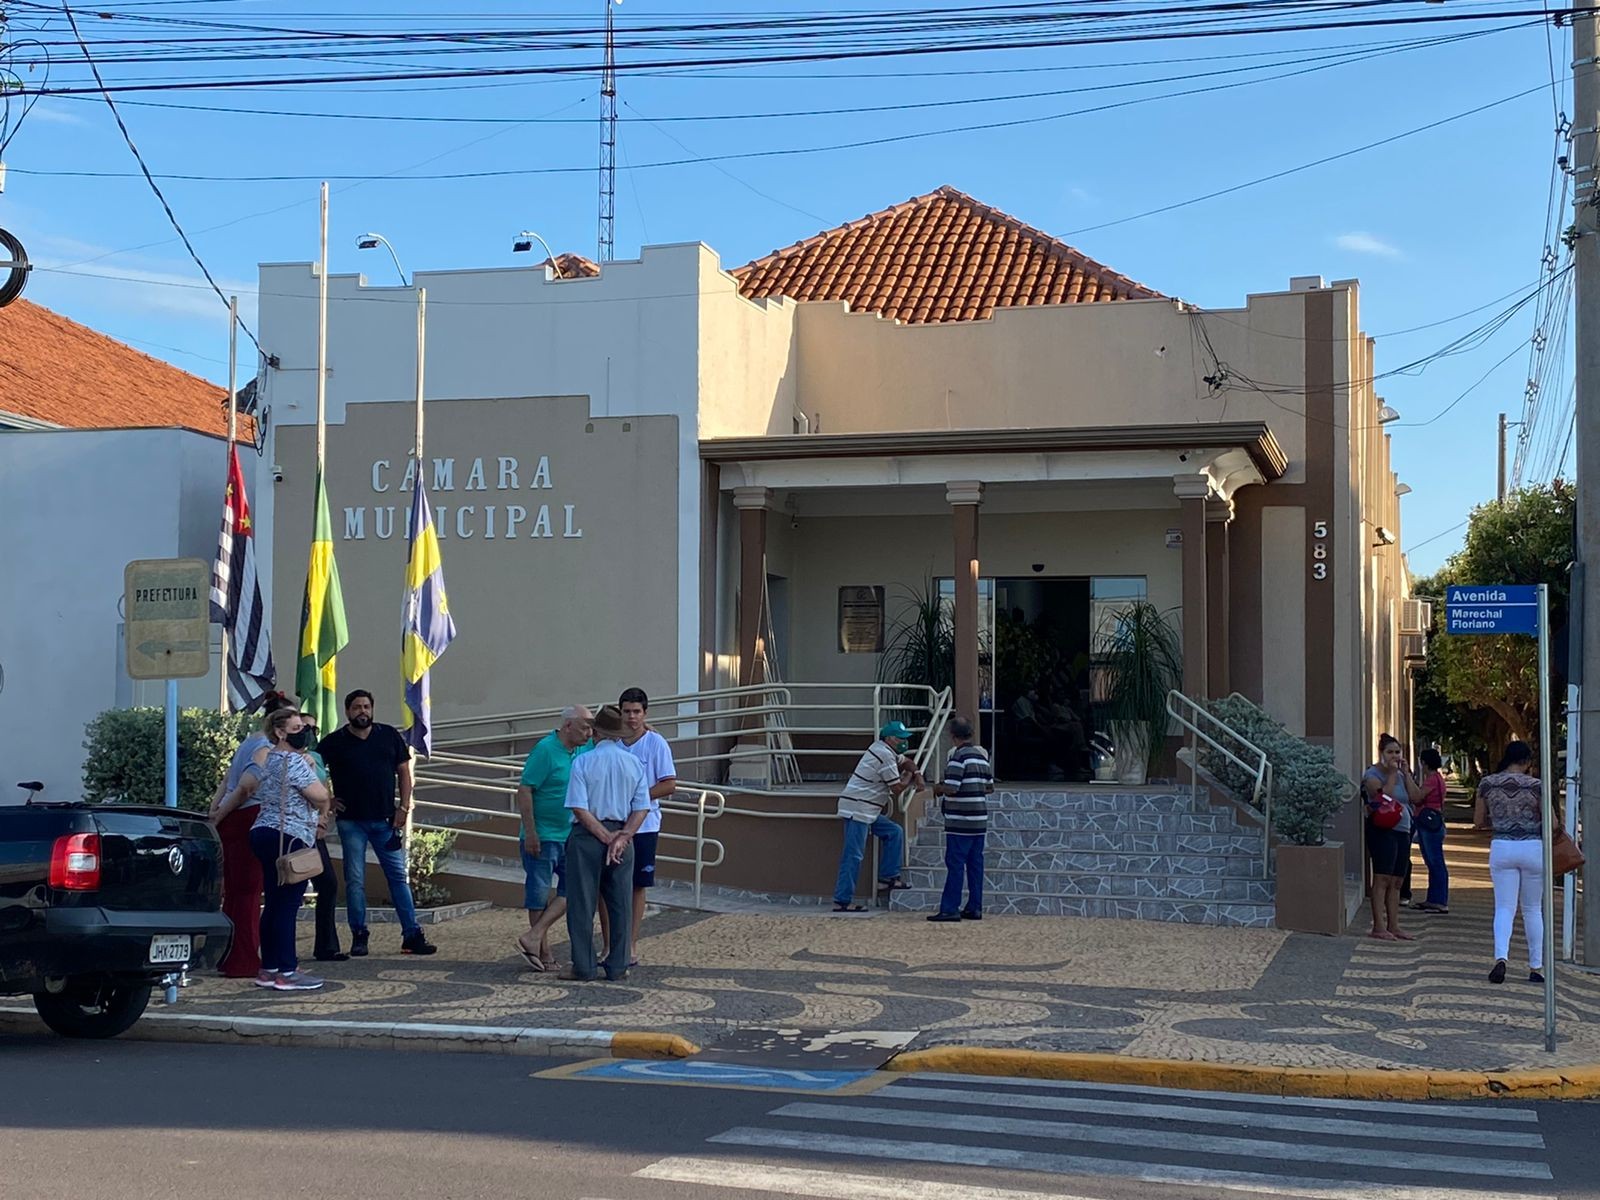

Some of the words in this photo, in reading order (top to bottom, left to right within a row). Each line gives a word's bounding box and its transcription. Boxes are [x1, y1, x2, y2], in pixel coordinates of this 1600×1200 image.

[1313, 521, 1328, 580] 583
[136, 587, 198, 602] PREFEITURA
[1452, 590, 1507, 602] Avenida
[1452, 609, 1503, 618] Marechal
[1452, 620, 1496, 629] Floriano
